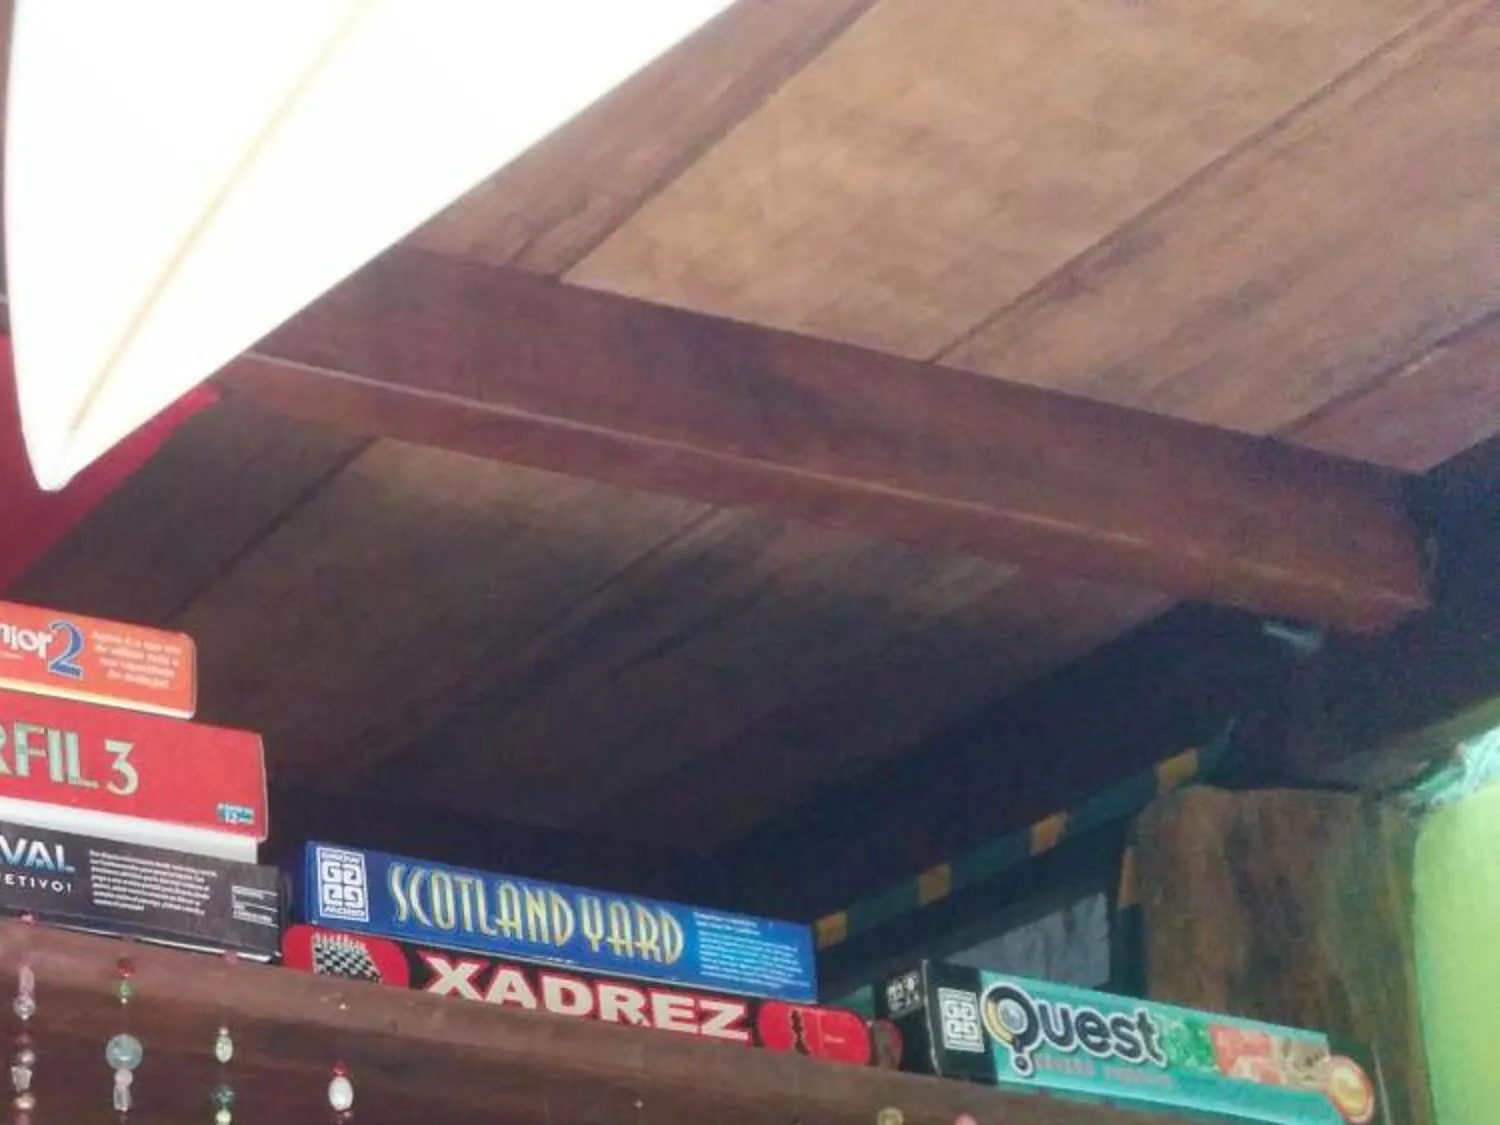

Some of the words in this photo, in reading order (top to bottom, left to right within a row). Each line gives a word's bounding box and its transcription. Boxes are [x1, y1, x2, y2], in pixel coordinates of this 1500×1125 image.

[47, 618, 85, 680] 2
[103, 739, 140, 796] 3
[387, 861, 575, 948] SCOTLAND
[580, 894, 685, 965] YARD
[420, 952, 751, 1042] XADREZ
[980, 981, 1168, 1078] Quest
